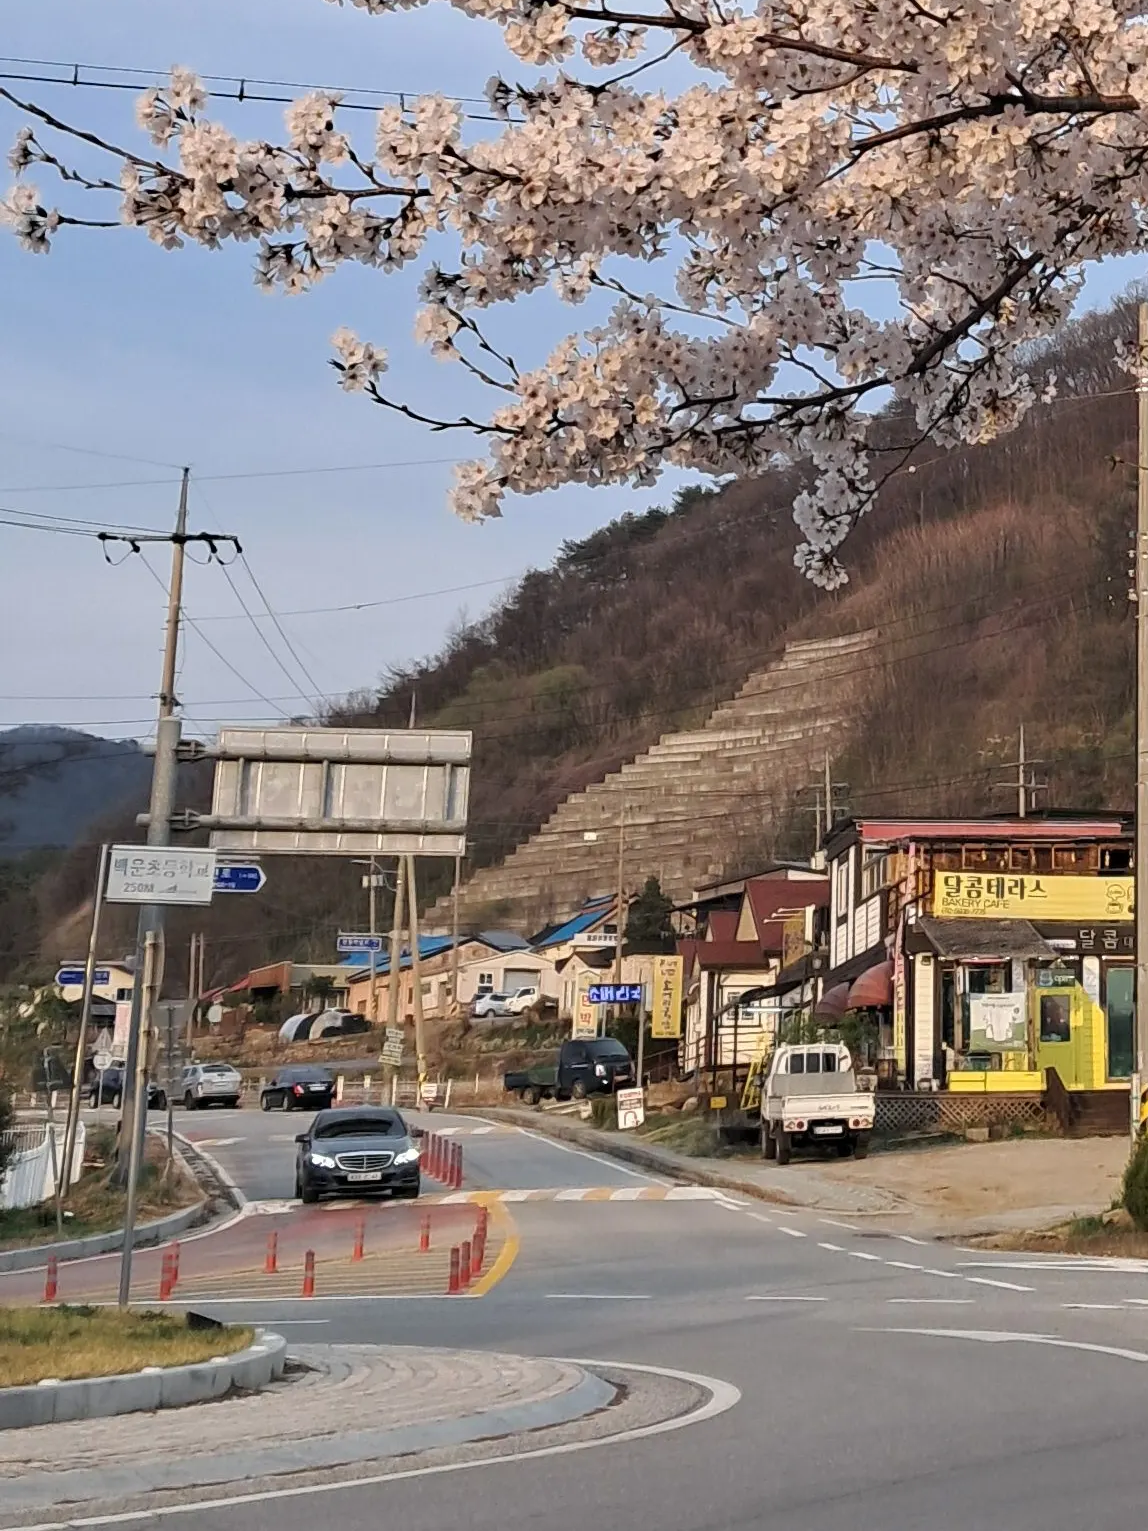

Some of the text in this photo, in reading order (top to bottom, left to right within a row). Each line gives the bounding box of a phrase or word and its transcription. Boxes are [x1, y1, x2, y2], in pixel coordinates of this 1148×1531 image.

[114, 858, 209, 879] 백운초등학교
[943, 874, 1048, 900] 달콤테라스
[941, 897, 1011, 911] BAKERY CAFE
